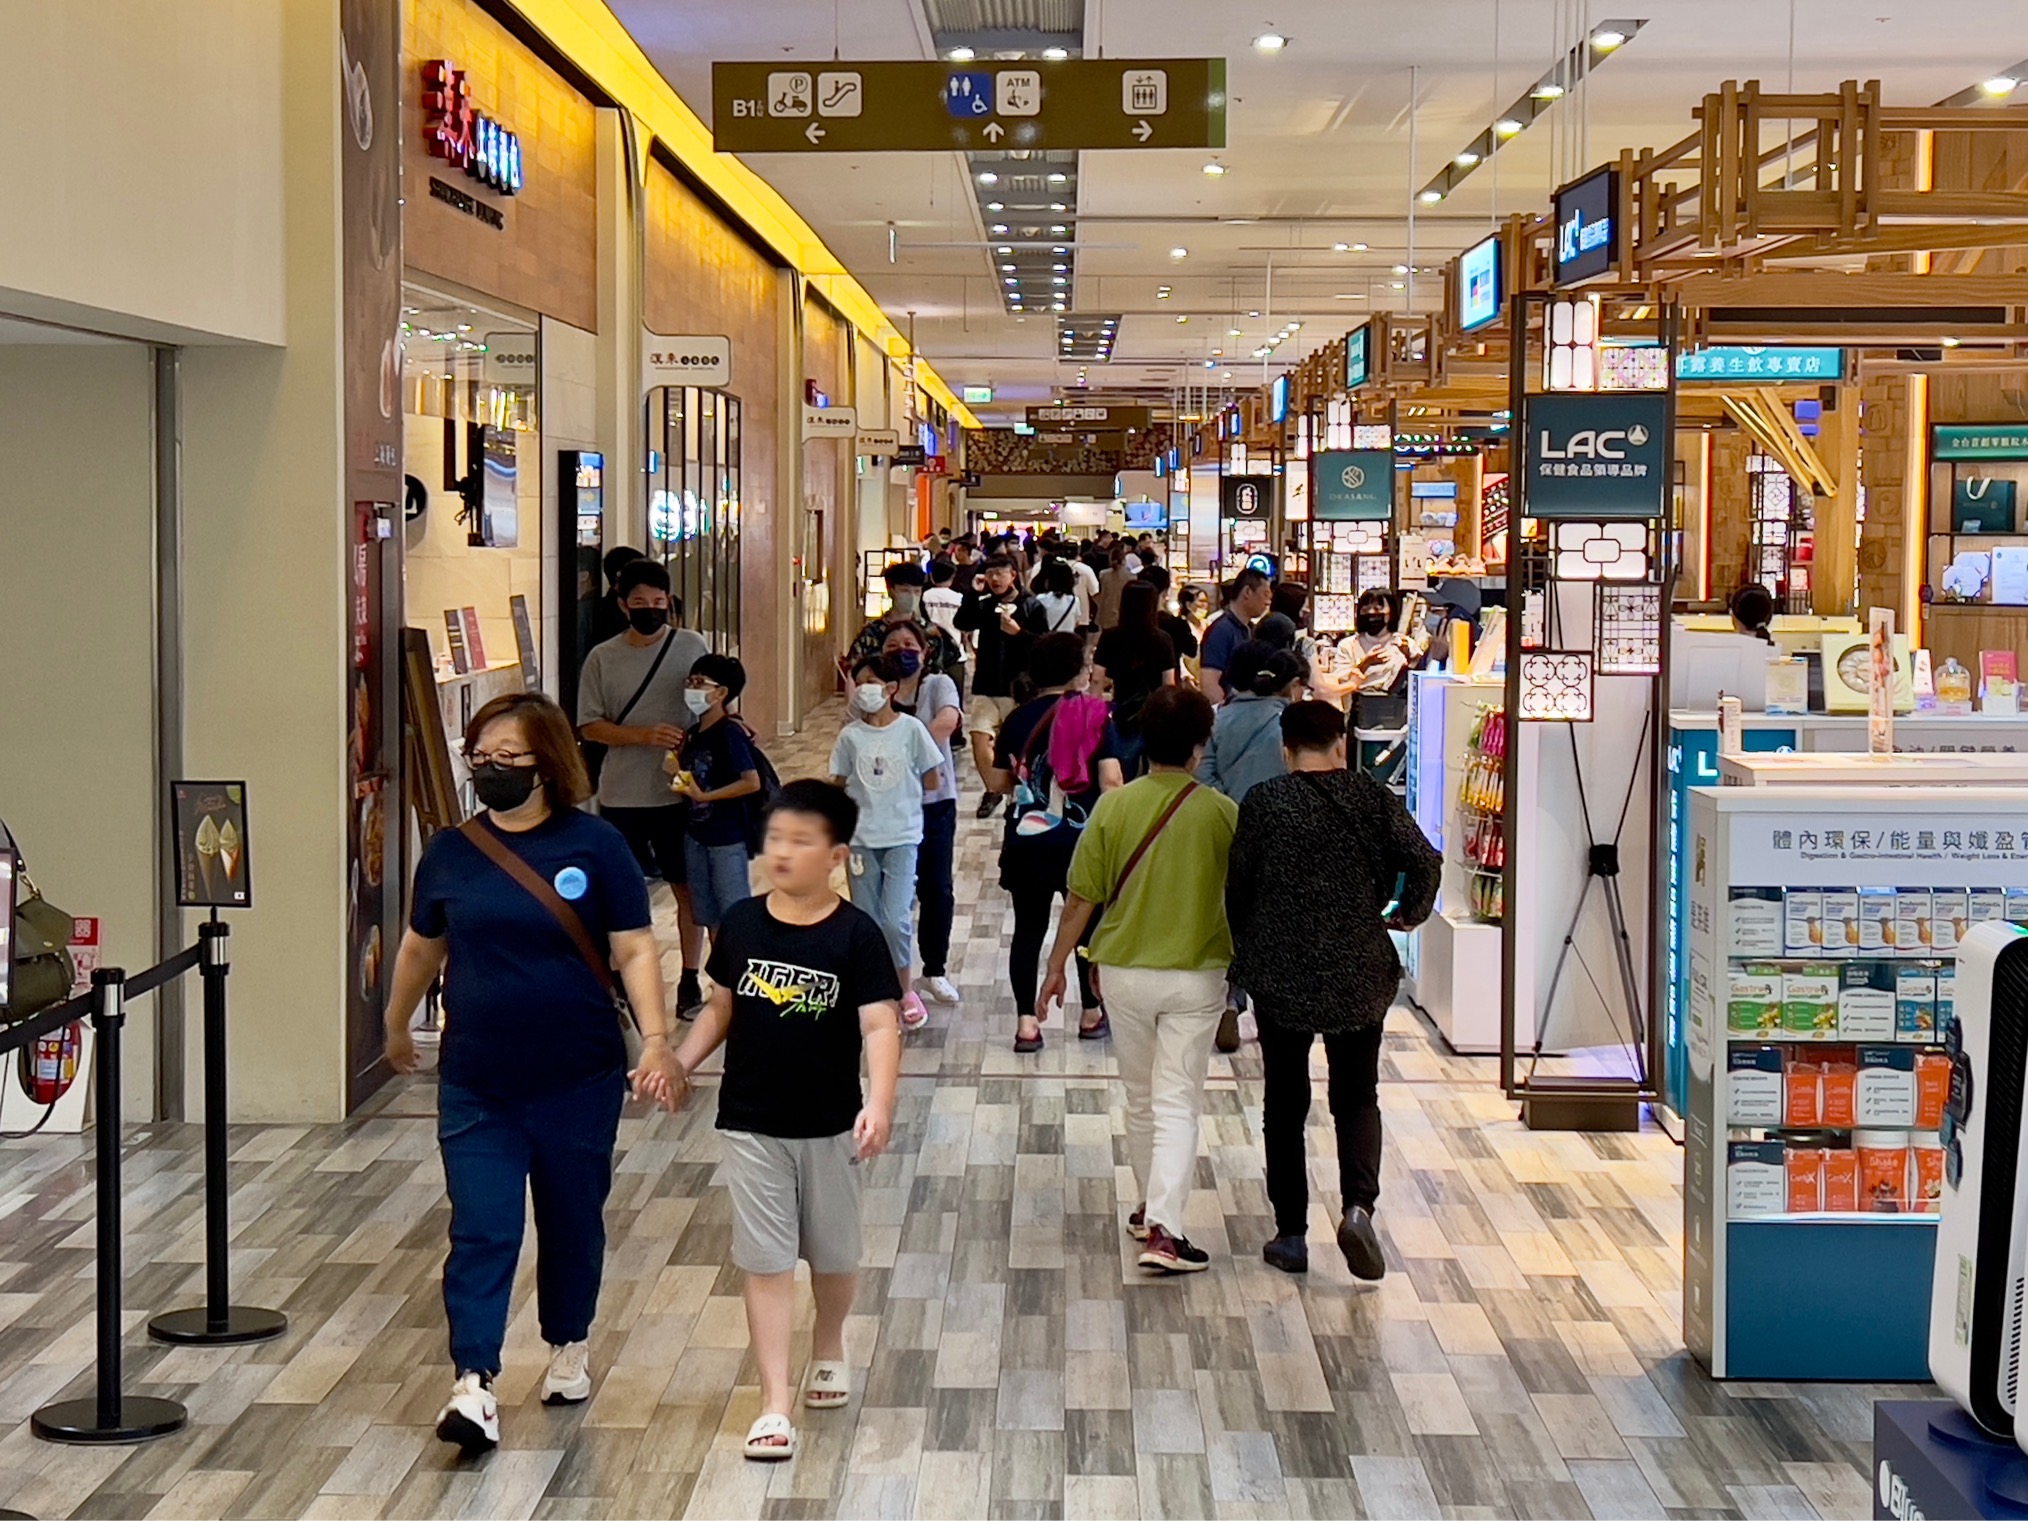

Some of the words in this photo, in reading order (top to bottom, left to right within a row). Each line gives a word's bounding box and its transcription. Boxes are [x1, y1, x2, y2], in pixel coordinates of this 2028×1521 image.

[1006, 77, 1031, 87] ATM
[1541, 430, 1626, 459] LAC
[1539, 463, 1648, 477] 保健食品領導品牌
[1951, 852, 1980, 861] Weight
[1869, 1156, 1898, 1168] Shake
